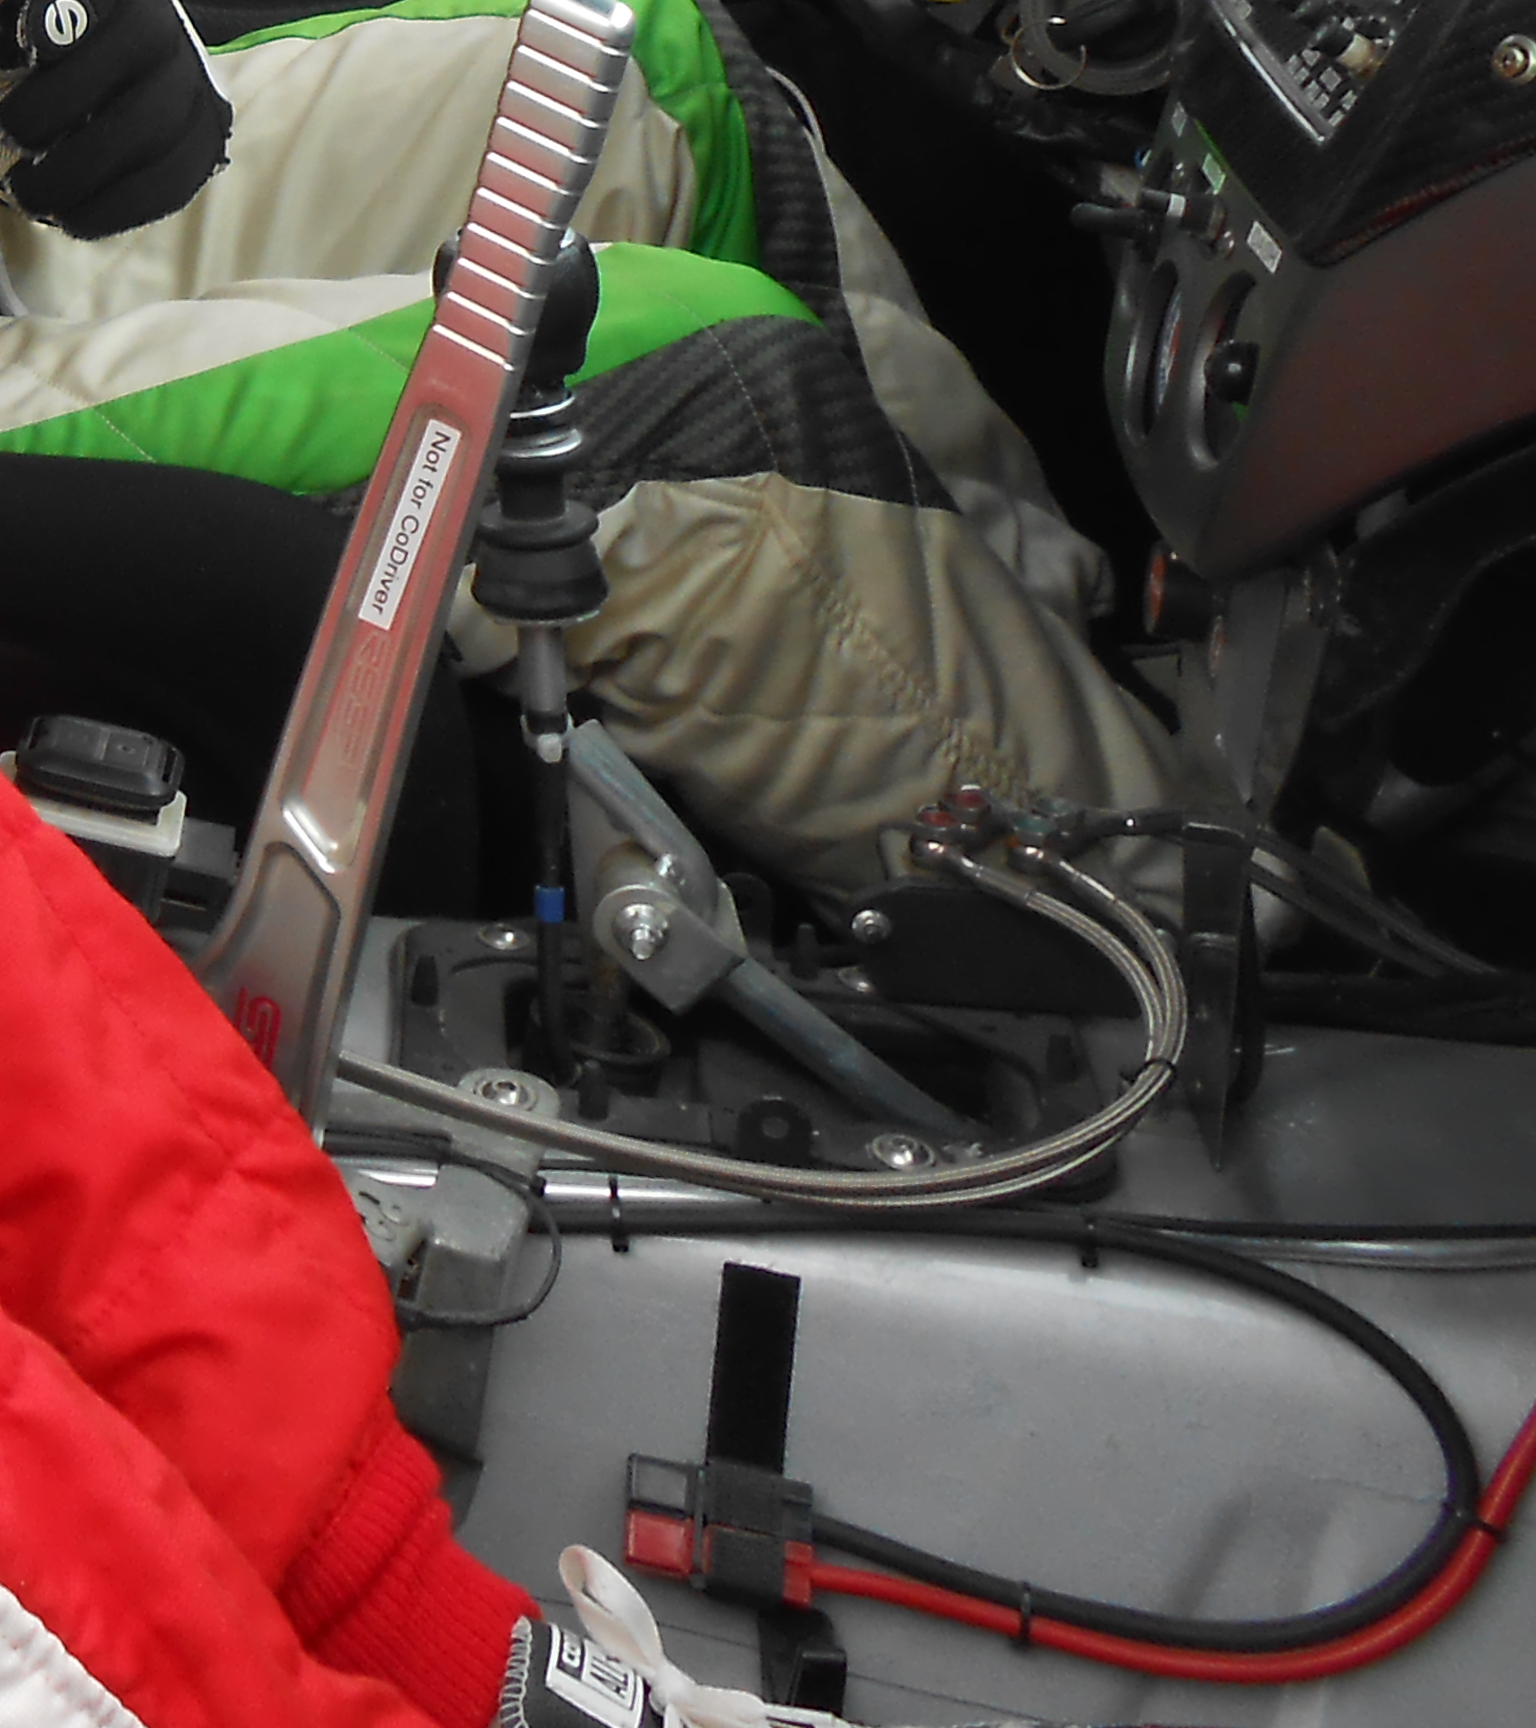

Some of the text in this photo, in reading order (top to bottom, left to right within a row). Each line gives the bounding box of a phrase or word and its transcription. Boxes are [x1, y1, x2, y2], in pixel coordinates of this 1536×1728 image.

[371, 430, 452, 616] Not for CoDriver
